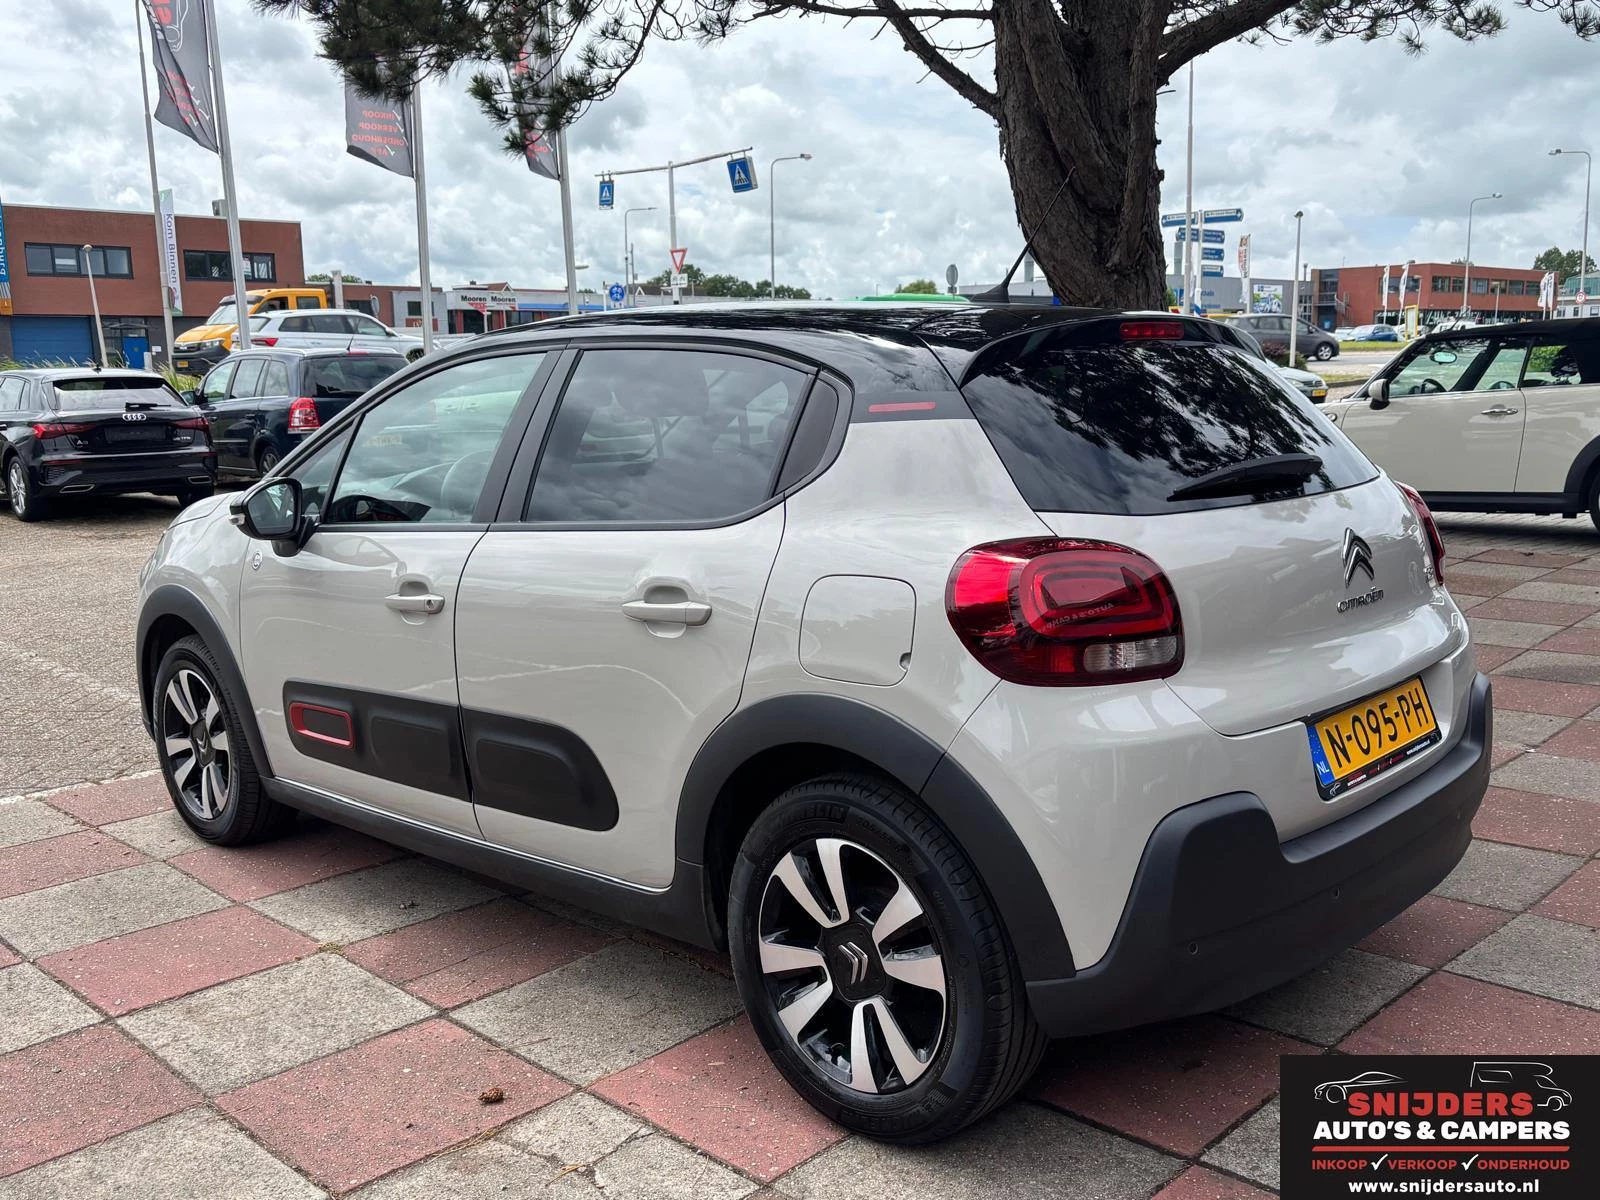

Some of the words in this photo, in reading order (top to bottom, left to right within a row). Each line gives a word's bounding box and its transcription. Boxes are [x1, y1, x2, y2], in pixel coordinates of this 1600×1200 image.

[168, 243, 177, 283] Binnen
[1337, 586, 1383, 613] CITROËN
[1325, 687, 1429, 768] N-095-PH
[1316, 761, 1330, 775] NL
